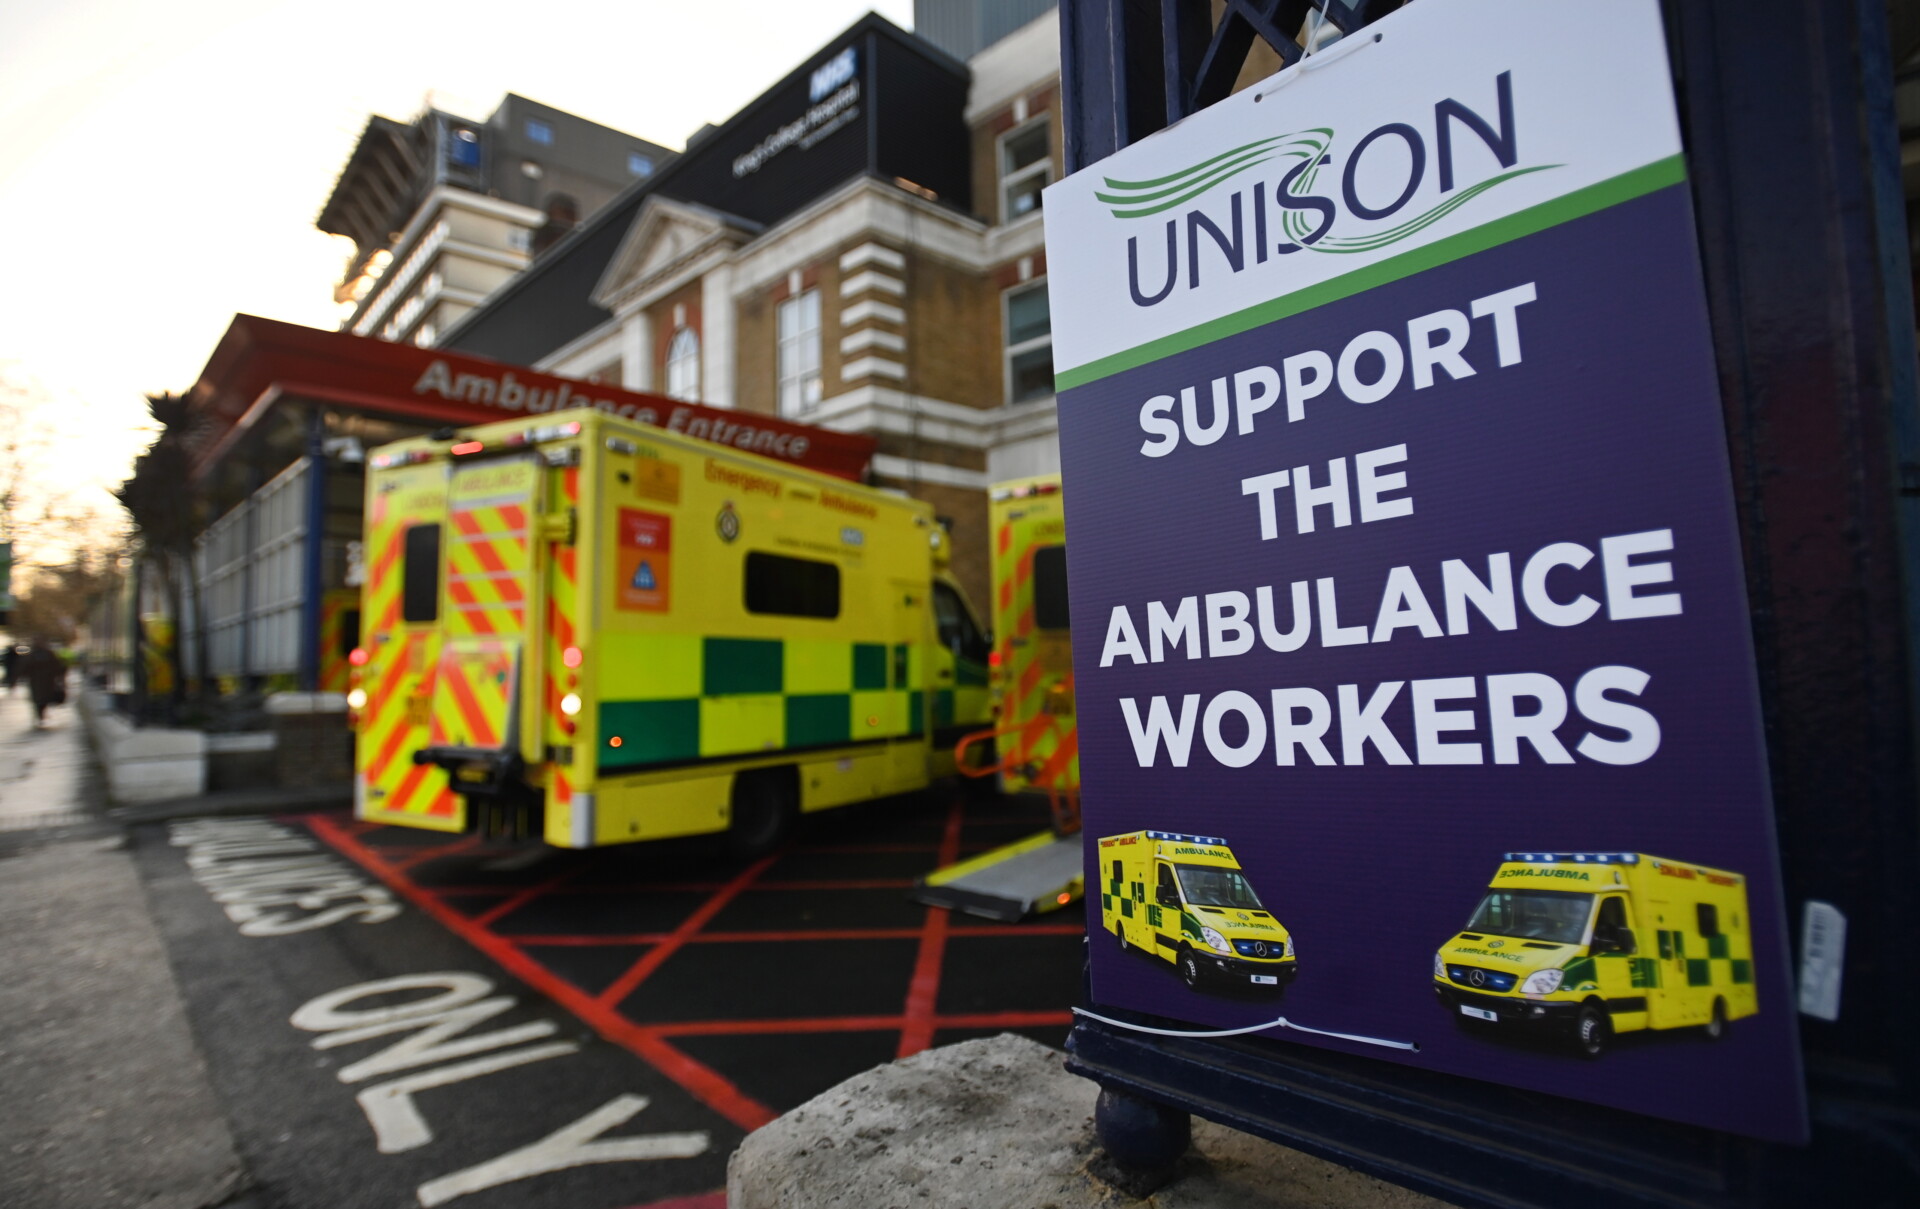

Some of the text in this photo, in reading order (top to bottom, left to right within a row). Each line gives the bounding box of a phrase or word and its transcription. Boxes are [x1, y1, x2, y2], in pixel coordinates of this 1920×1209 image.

[1128, 71, 1517, 307] UNISON
[1139, 281, 1537, 458] SUPPORT
[666, 405, 810, 458] Entrance
[1241, 443, 1414, 541] THE
[1099, 529, 1682, 668] AMBULANCE
[1119, 665, 1660, 768] WORKERS
[1174, 846, 1233, 861] AMBULANCE
[1454, 945, 1525, 963] AMBULANCE
[290, 971, 711, 1208] ONLY
